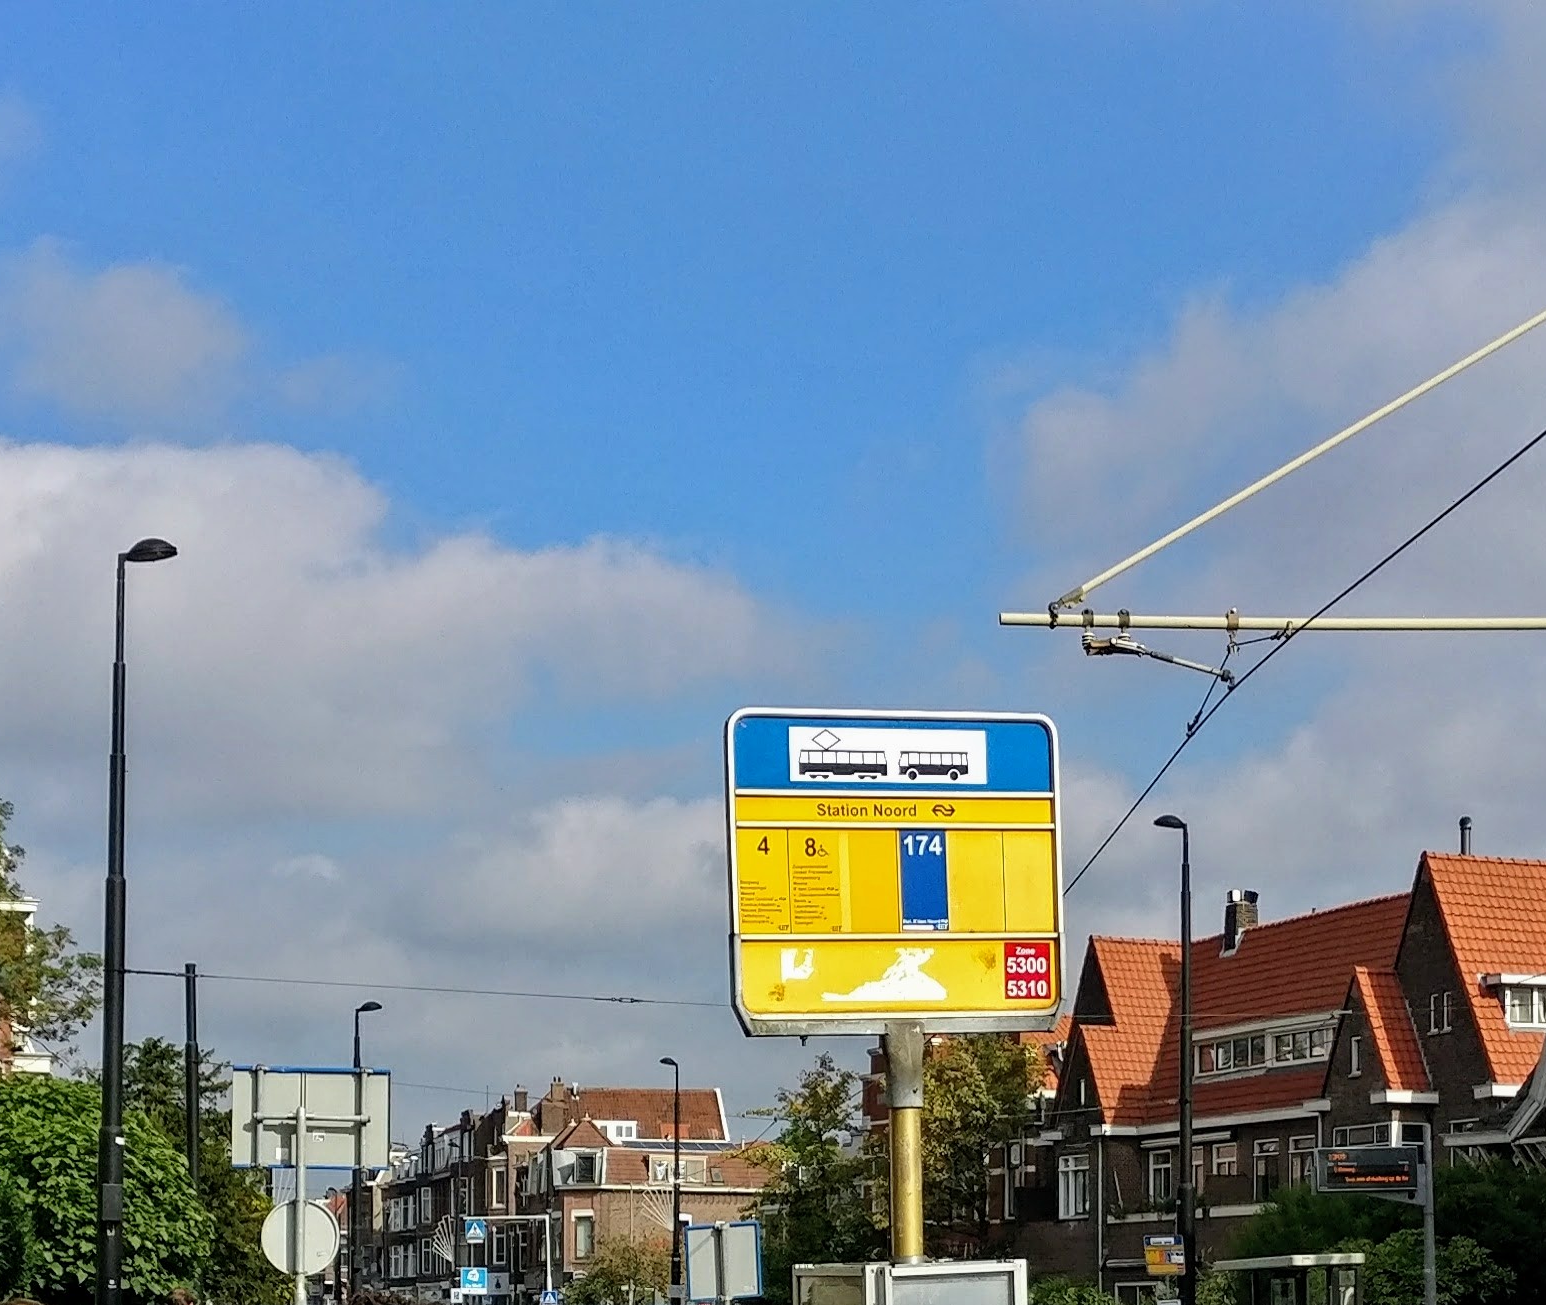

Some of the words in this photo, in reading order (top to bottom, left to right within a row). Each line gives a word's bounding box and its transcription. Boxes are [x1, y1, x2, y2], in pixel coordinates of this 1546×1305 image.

[816, 803, 868, 817] Station
[873, 804, 917, 817] Noord
[757, 836, 770, 855] 4
[804, 837, 817, 857] 8
[903, 834, 943, 856] 174
[1015, 946, 1036, 956] Zone
[1006, 956, 1047, 974] 5300
[1007, 979, 1047, 997] 5310
